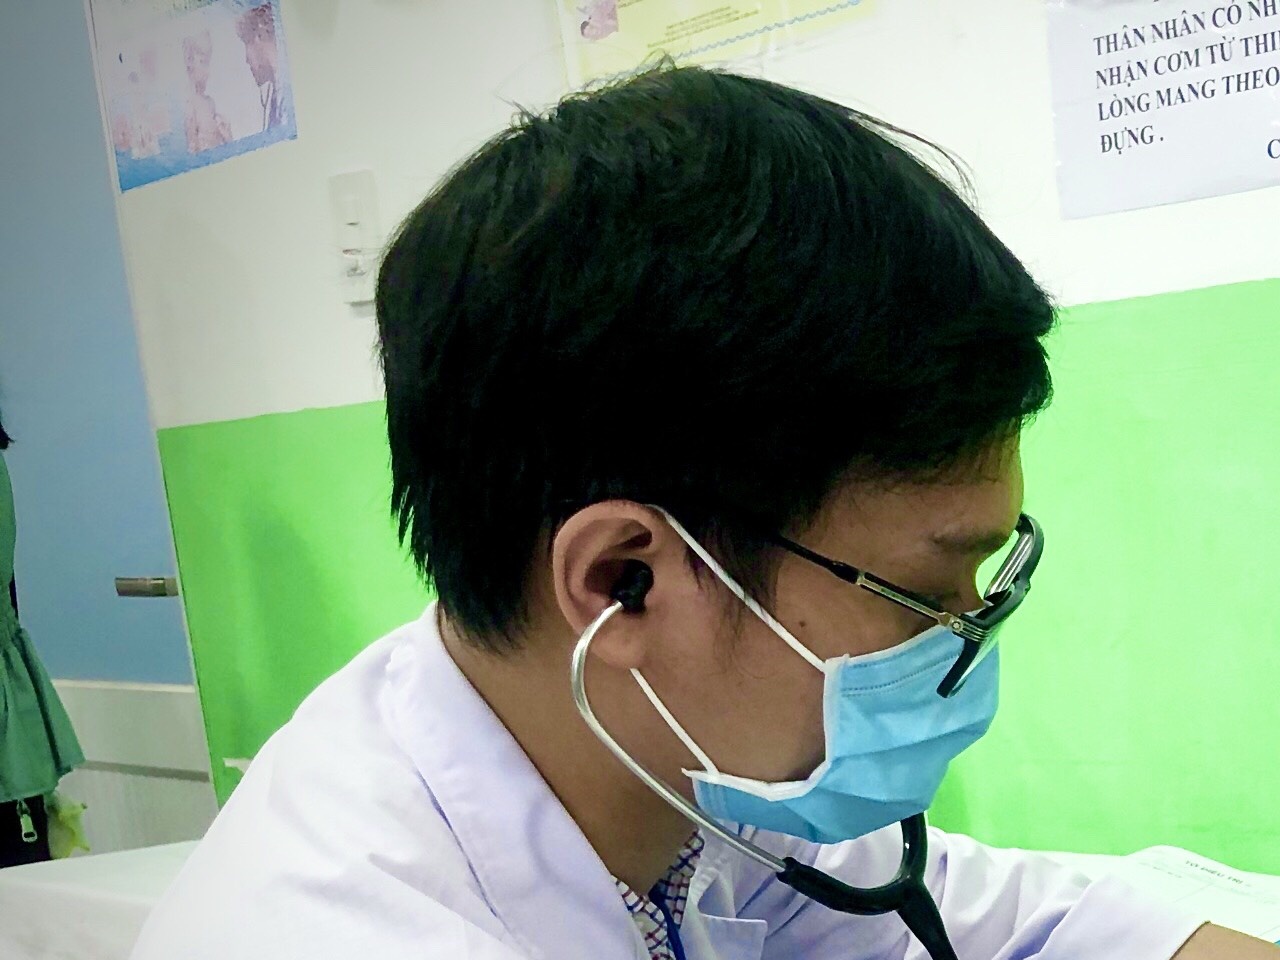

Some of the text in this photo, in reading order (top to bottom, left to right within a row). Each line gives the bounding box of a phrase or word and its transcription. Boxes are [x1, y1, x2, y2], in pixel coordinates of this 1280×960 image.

[1093, 25, 1146, 56] THÂN
[1151, 10, 1206, 43] NHÂN
[1096, 60, 1148, 89] NHẬN
[1154, 48, 1200, 75] CƠM
[1206, 36, 1235, 64] TỪ
[1098, 94, 1151, 121] LÒNG
[1156, 79, 1216, 109] MANG
[1222, 66, 1280, 95] THEO
